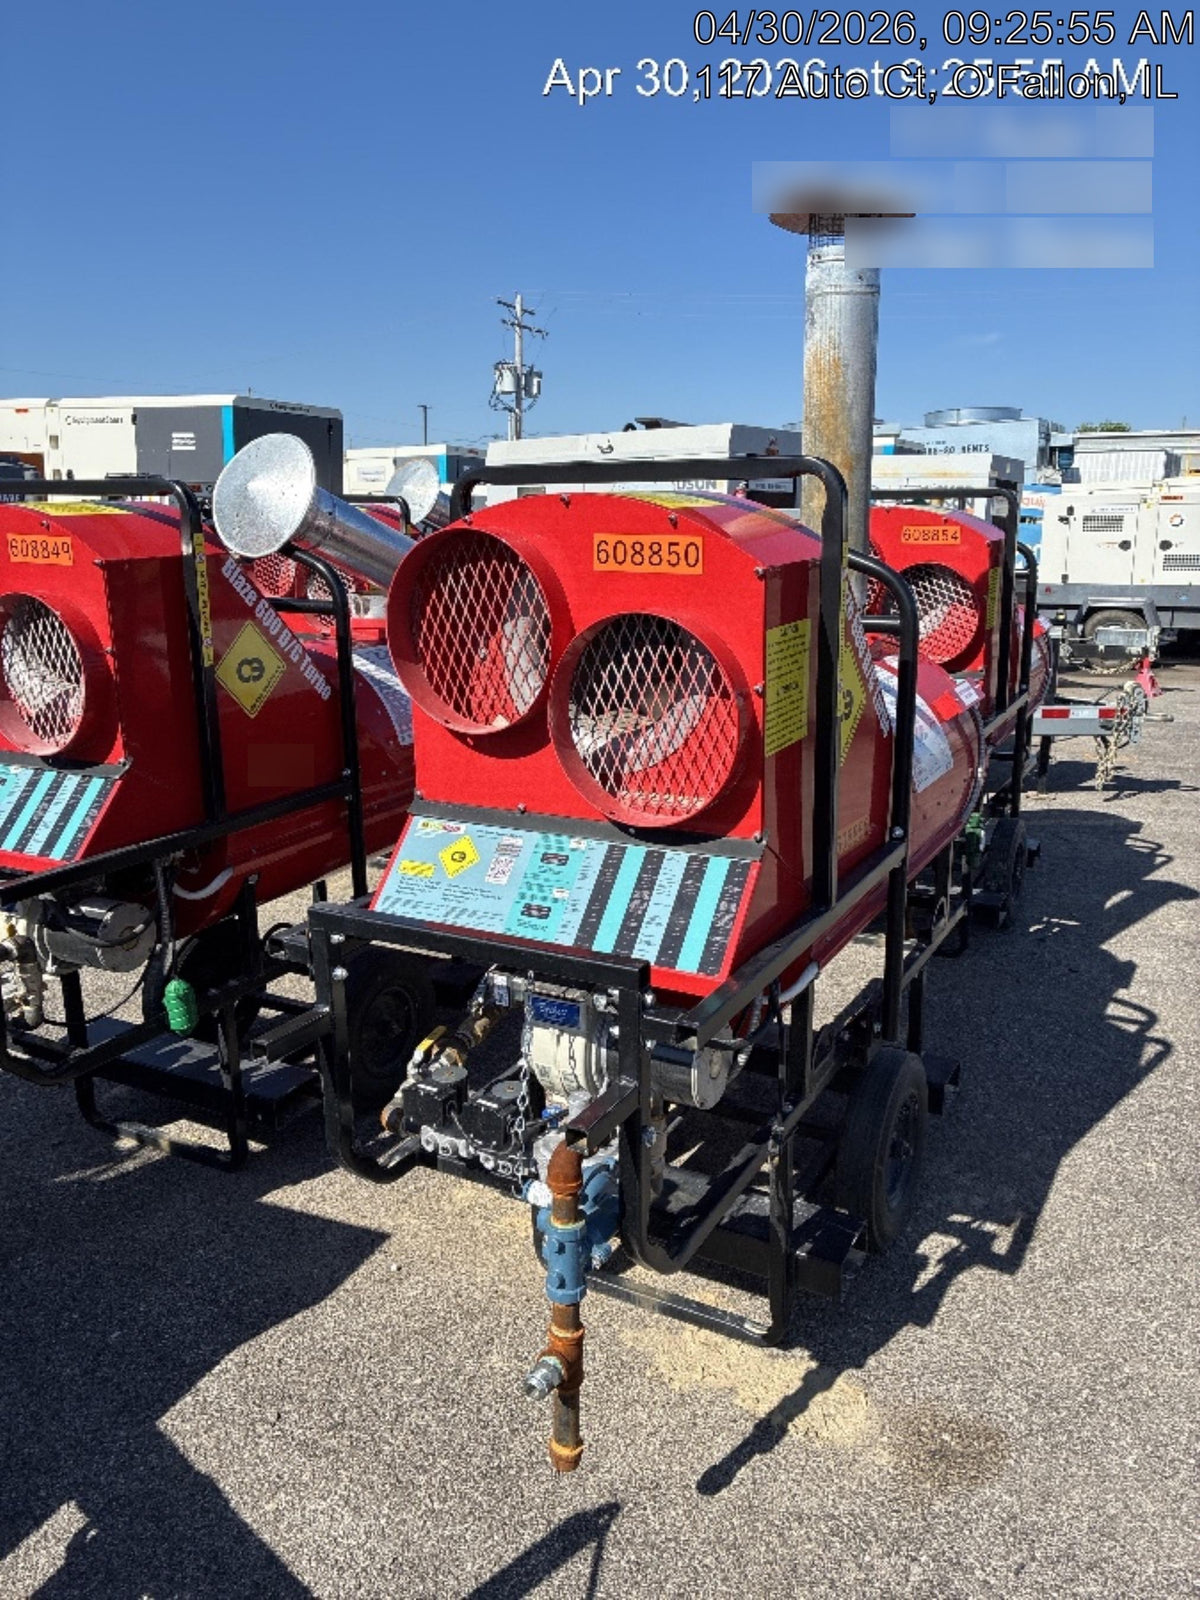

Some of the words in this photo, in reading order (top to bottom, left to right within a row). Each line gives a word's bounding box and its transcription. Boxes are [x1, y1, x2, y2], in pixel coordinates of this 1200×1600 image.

[902, 527, 960, 542] 608854
[9, 537, 72, 561] 608849
[596, 539, 700, 569] 608850
[221, 556, 258, 607] Blaze
[254, 598, 282, 636] 600
[300, 651, 332, 701] Turbo
